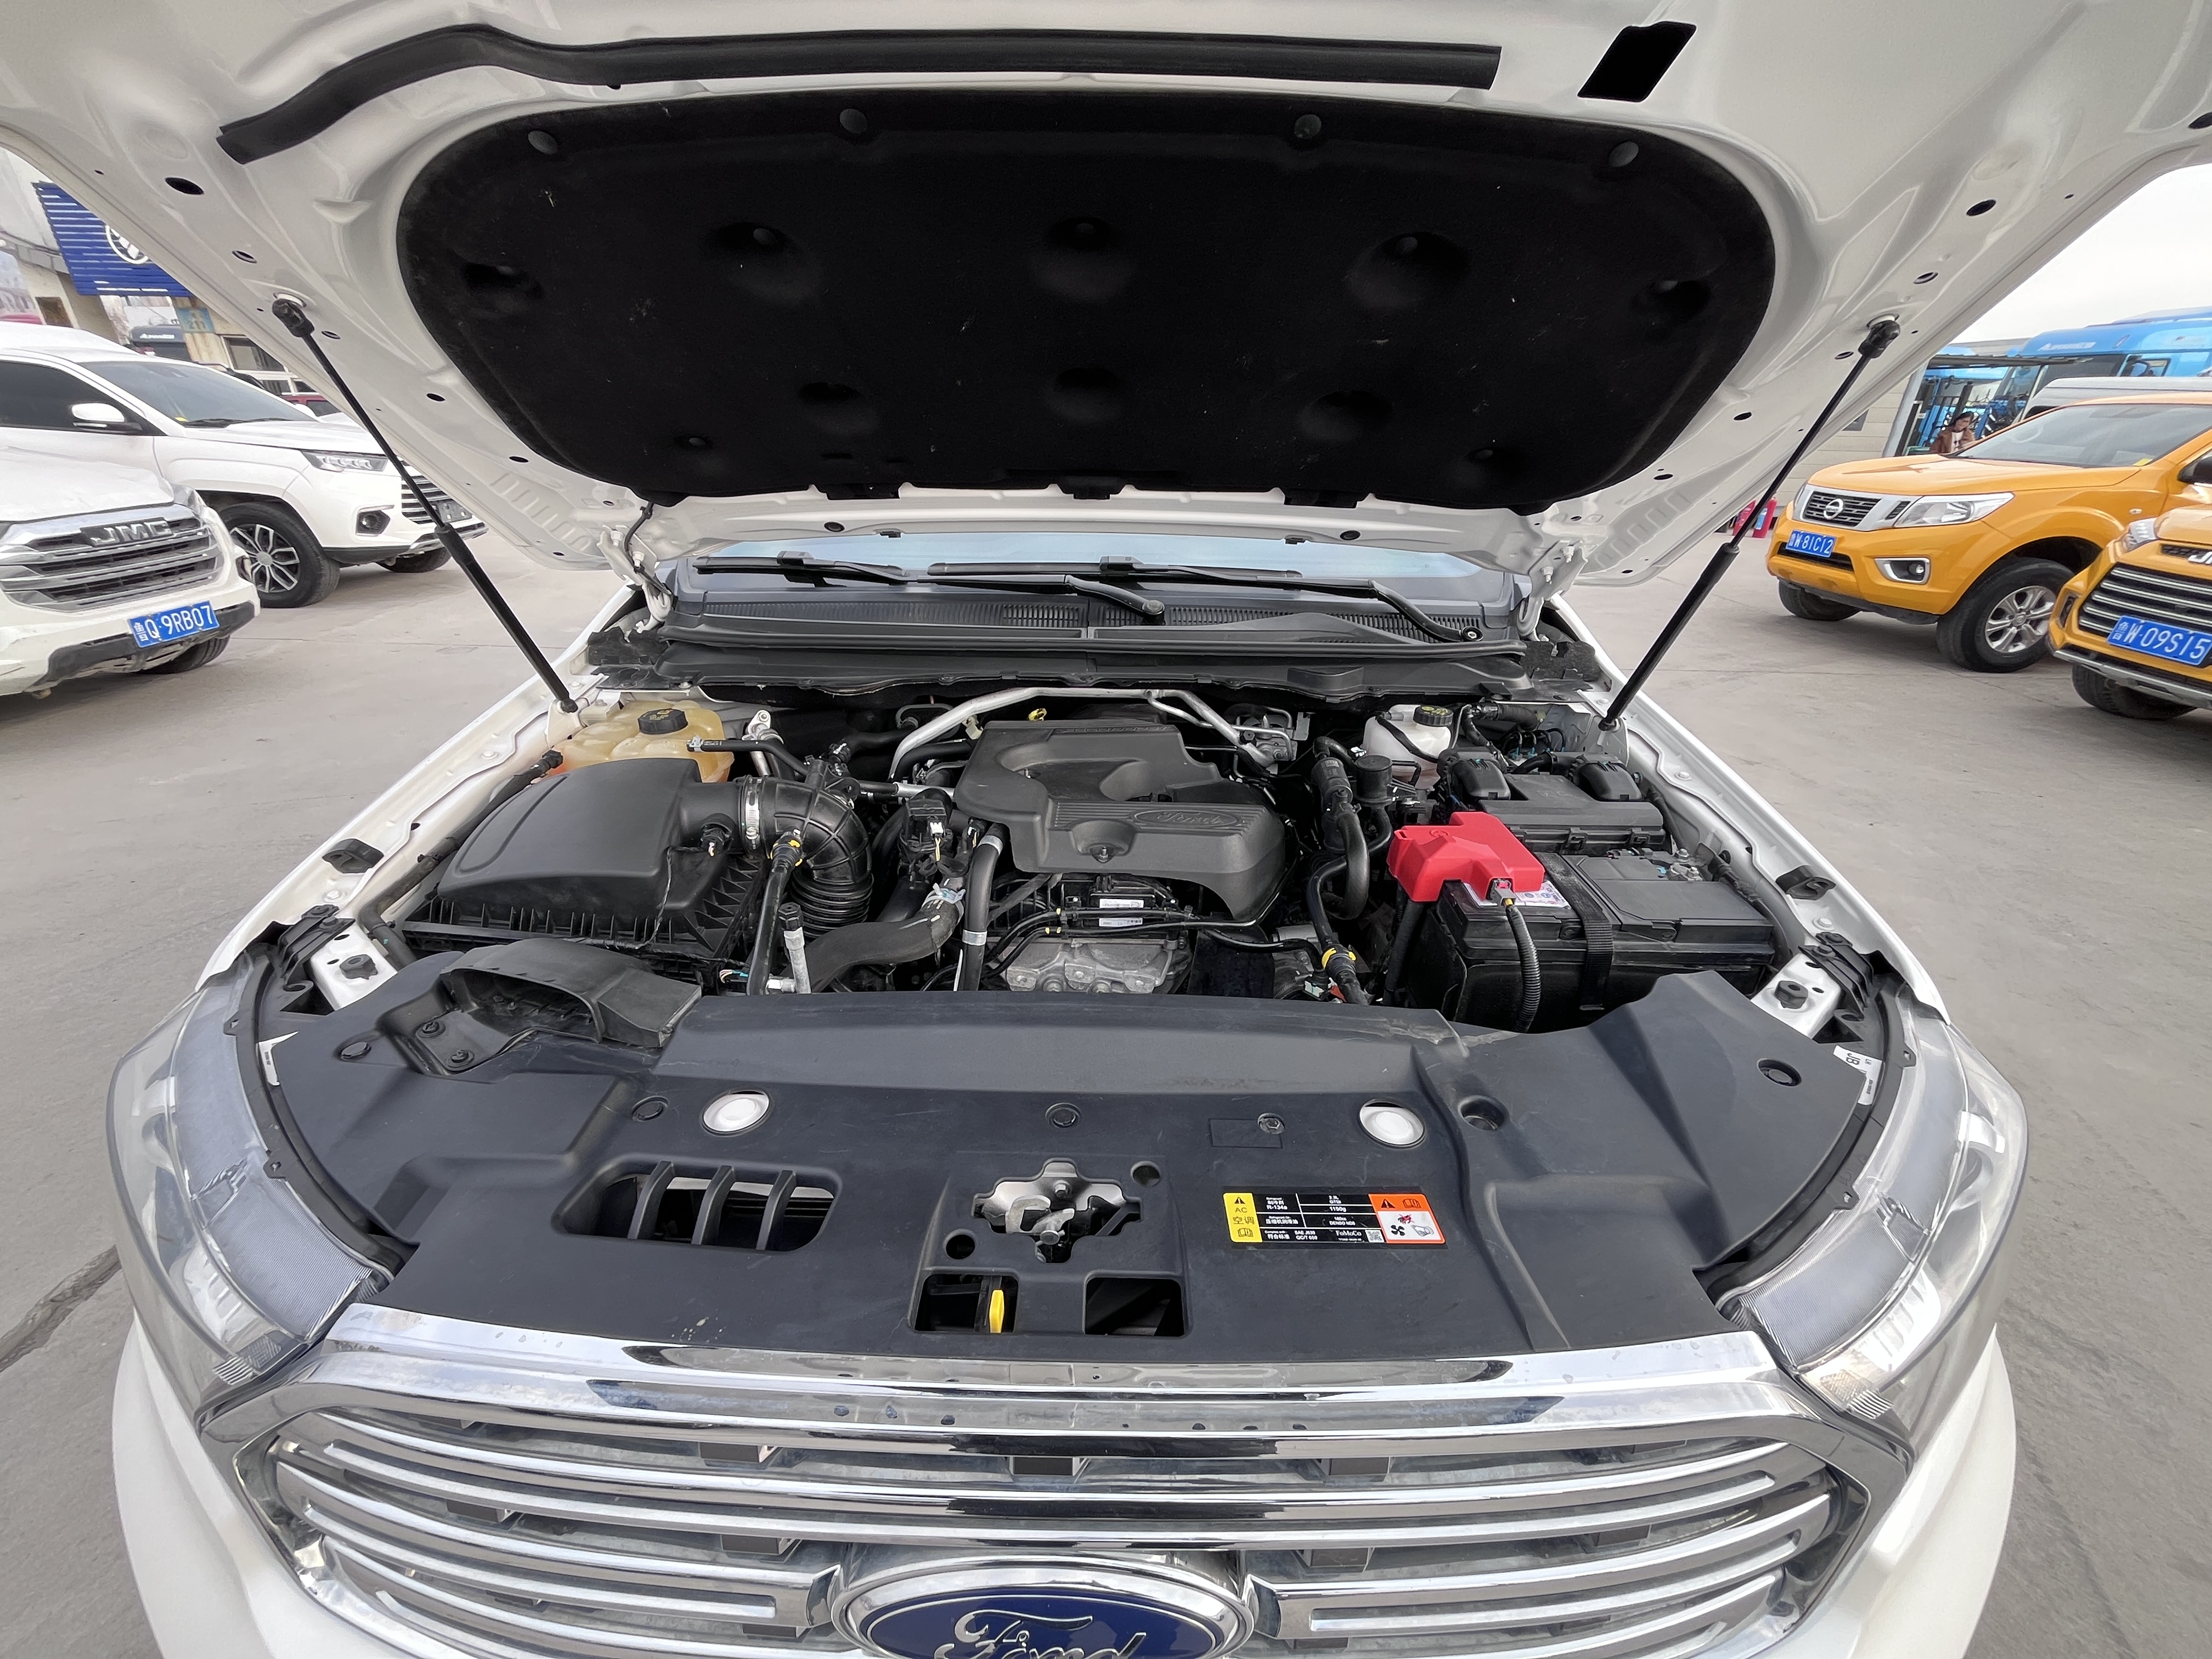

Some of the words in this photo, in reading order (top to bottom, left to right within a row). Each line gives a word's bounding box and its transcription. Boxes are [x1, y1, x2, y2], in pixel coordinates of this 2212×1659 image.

[89, 520, 173, 544] JMC
[2187, 551, 2212, 565] J
[1157, 812, 1224, 824] Ford
[1846, 1053, 1860, 1065] JB
[1233, 1216, 1255, 1225] 空调
